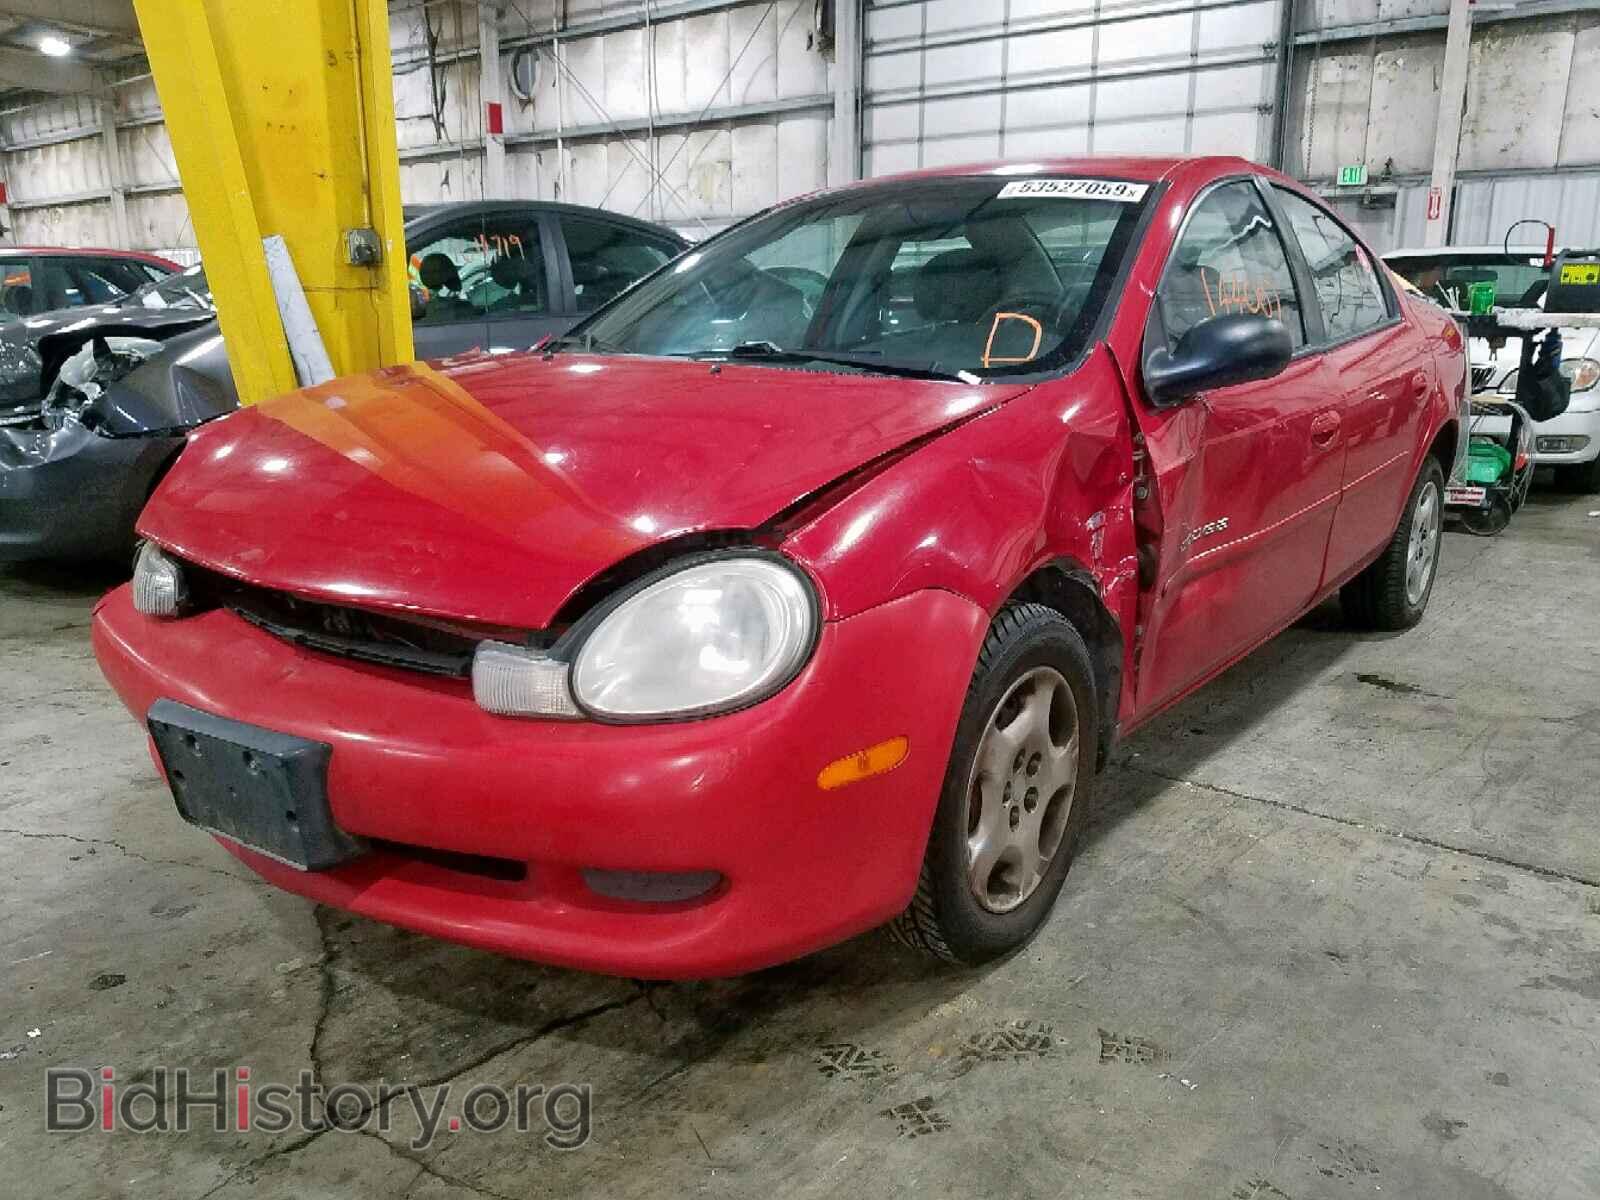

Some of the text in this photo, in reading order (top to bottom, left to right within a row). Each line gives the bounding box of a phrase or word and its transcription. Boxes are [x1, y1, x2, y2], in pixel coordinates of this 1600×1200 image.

[1342, 167, 1363, 183] EXIT
[1018, 180, 1128, 197] 53527059
[981, 312, 1042, 368] D
